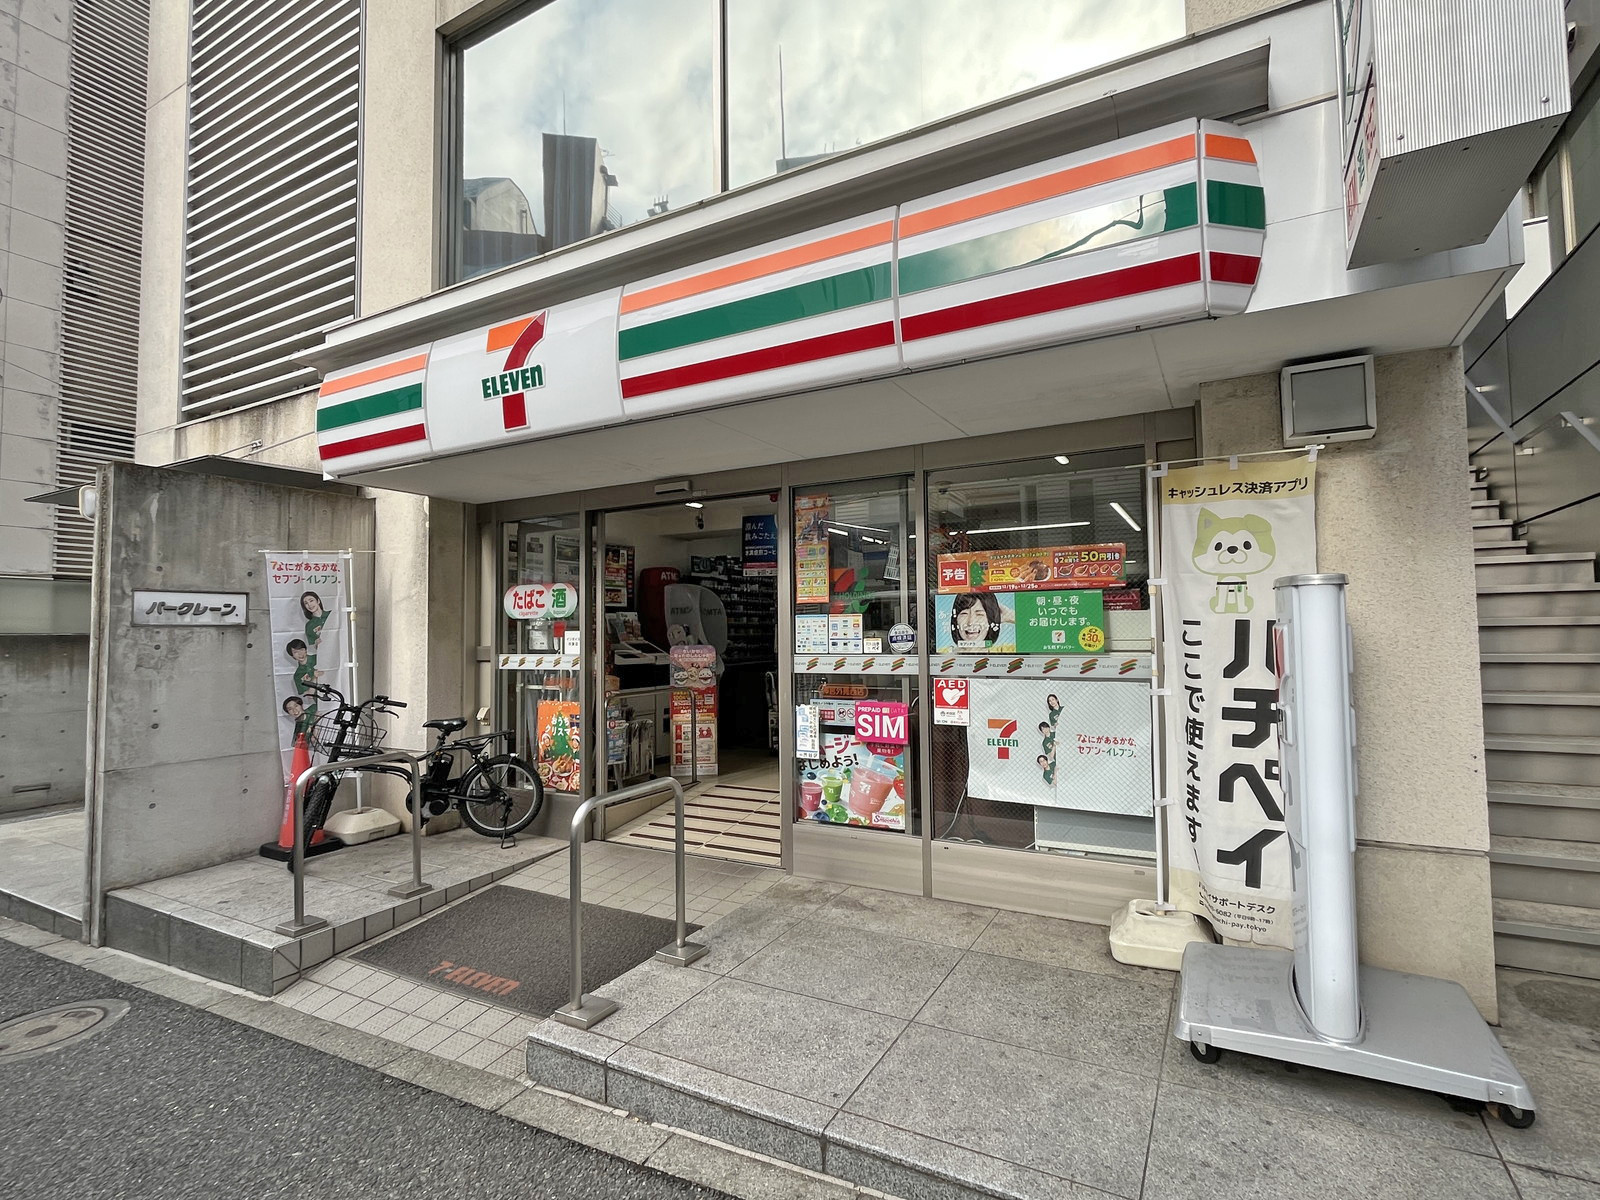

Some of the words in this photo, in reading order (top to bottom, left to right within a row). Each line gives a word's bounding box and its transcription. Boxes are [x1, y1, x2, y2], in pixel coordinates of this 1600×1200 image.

[1167, 476, 1309, 499] キャッシュレス決済アプリ
[1080, 550, 1120, 563] 50円引き
[942, 568, 967, 582] 予告
[512, 588, 545, 610] たばこ
[551, 588, 567, 608] 酒
[1035, 595, 1080, 606] 朝・昼・夜
[1038, 606, 1078, 616] いつでも
[1029, 616, 1091, 627] お届けします。
[937, 679, 967, 689] AED
[857, 705, 881, 713] PREPAID
[551, 713, 570, 727] おうち
[857, 714, 905, 739] SIM
[545, 724, 580, 736] クリスマス
[824, 734, 862, 755] ージー
[1216, 619, 1287, 889] ハチペイ
